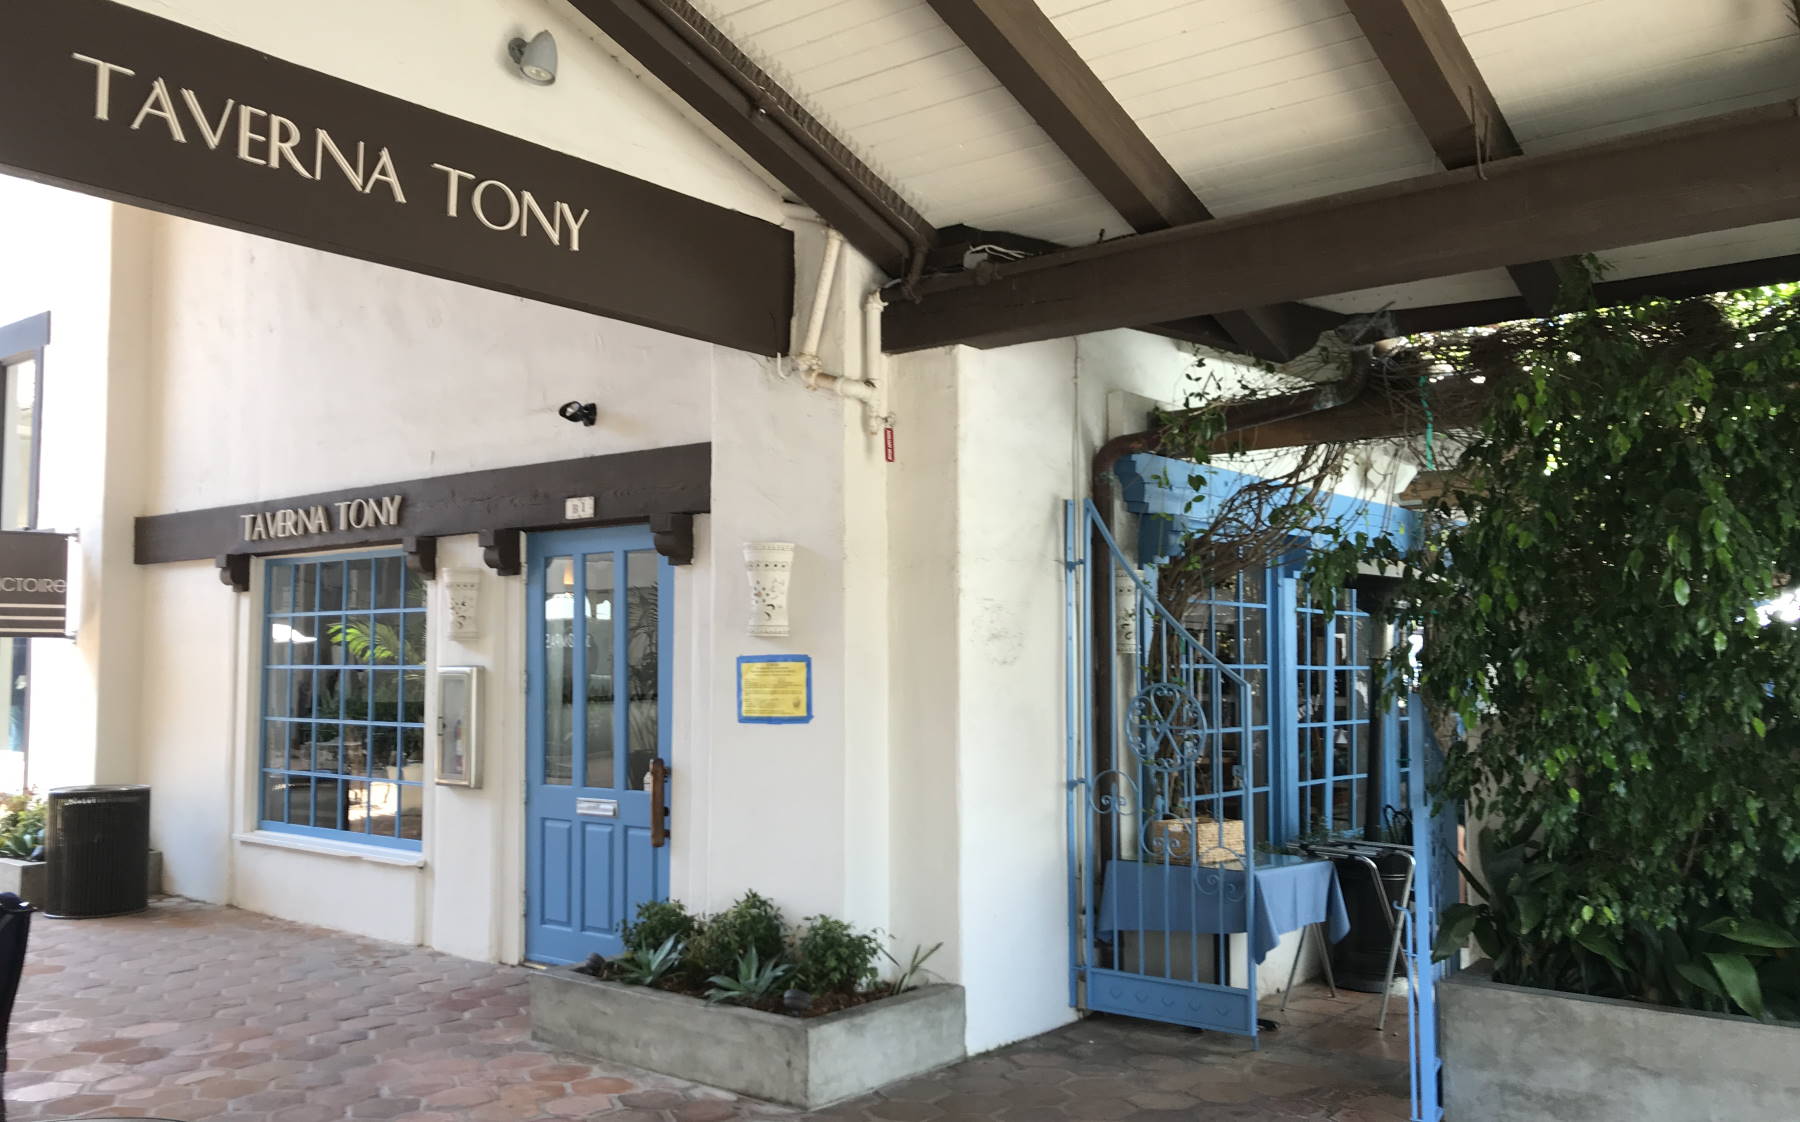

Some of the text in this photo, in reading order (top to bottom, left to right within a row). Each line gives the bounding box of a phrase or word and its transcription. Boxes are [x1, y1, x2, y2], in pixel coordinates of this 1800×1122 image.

[72, 52, 590, 253] TAVERNA TONY
[240, 494, 403, 542] TAVERNA TONY
[0, 576, 67, 593] CTOIRe
